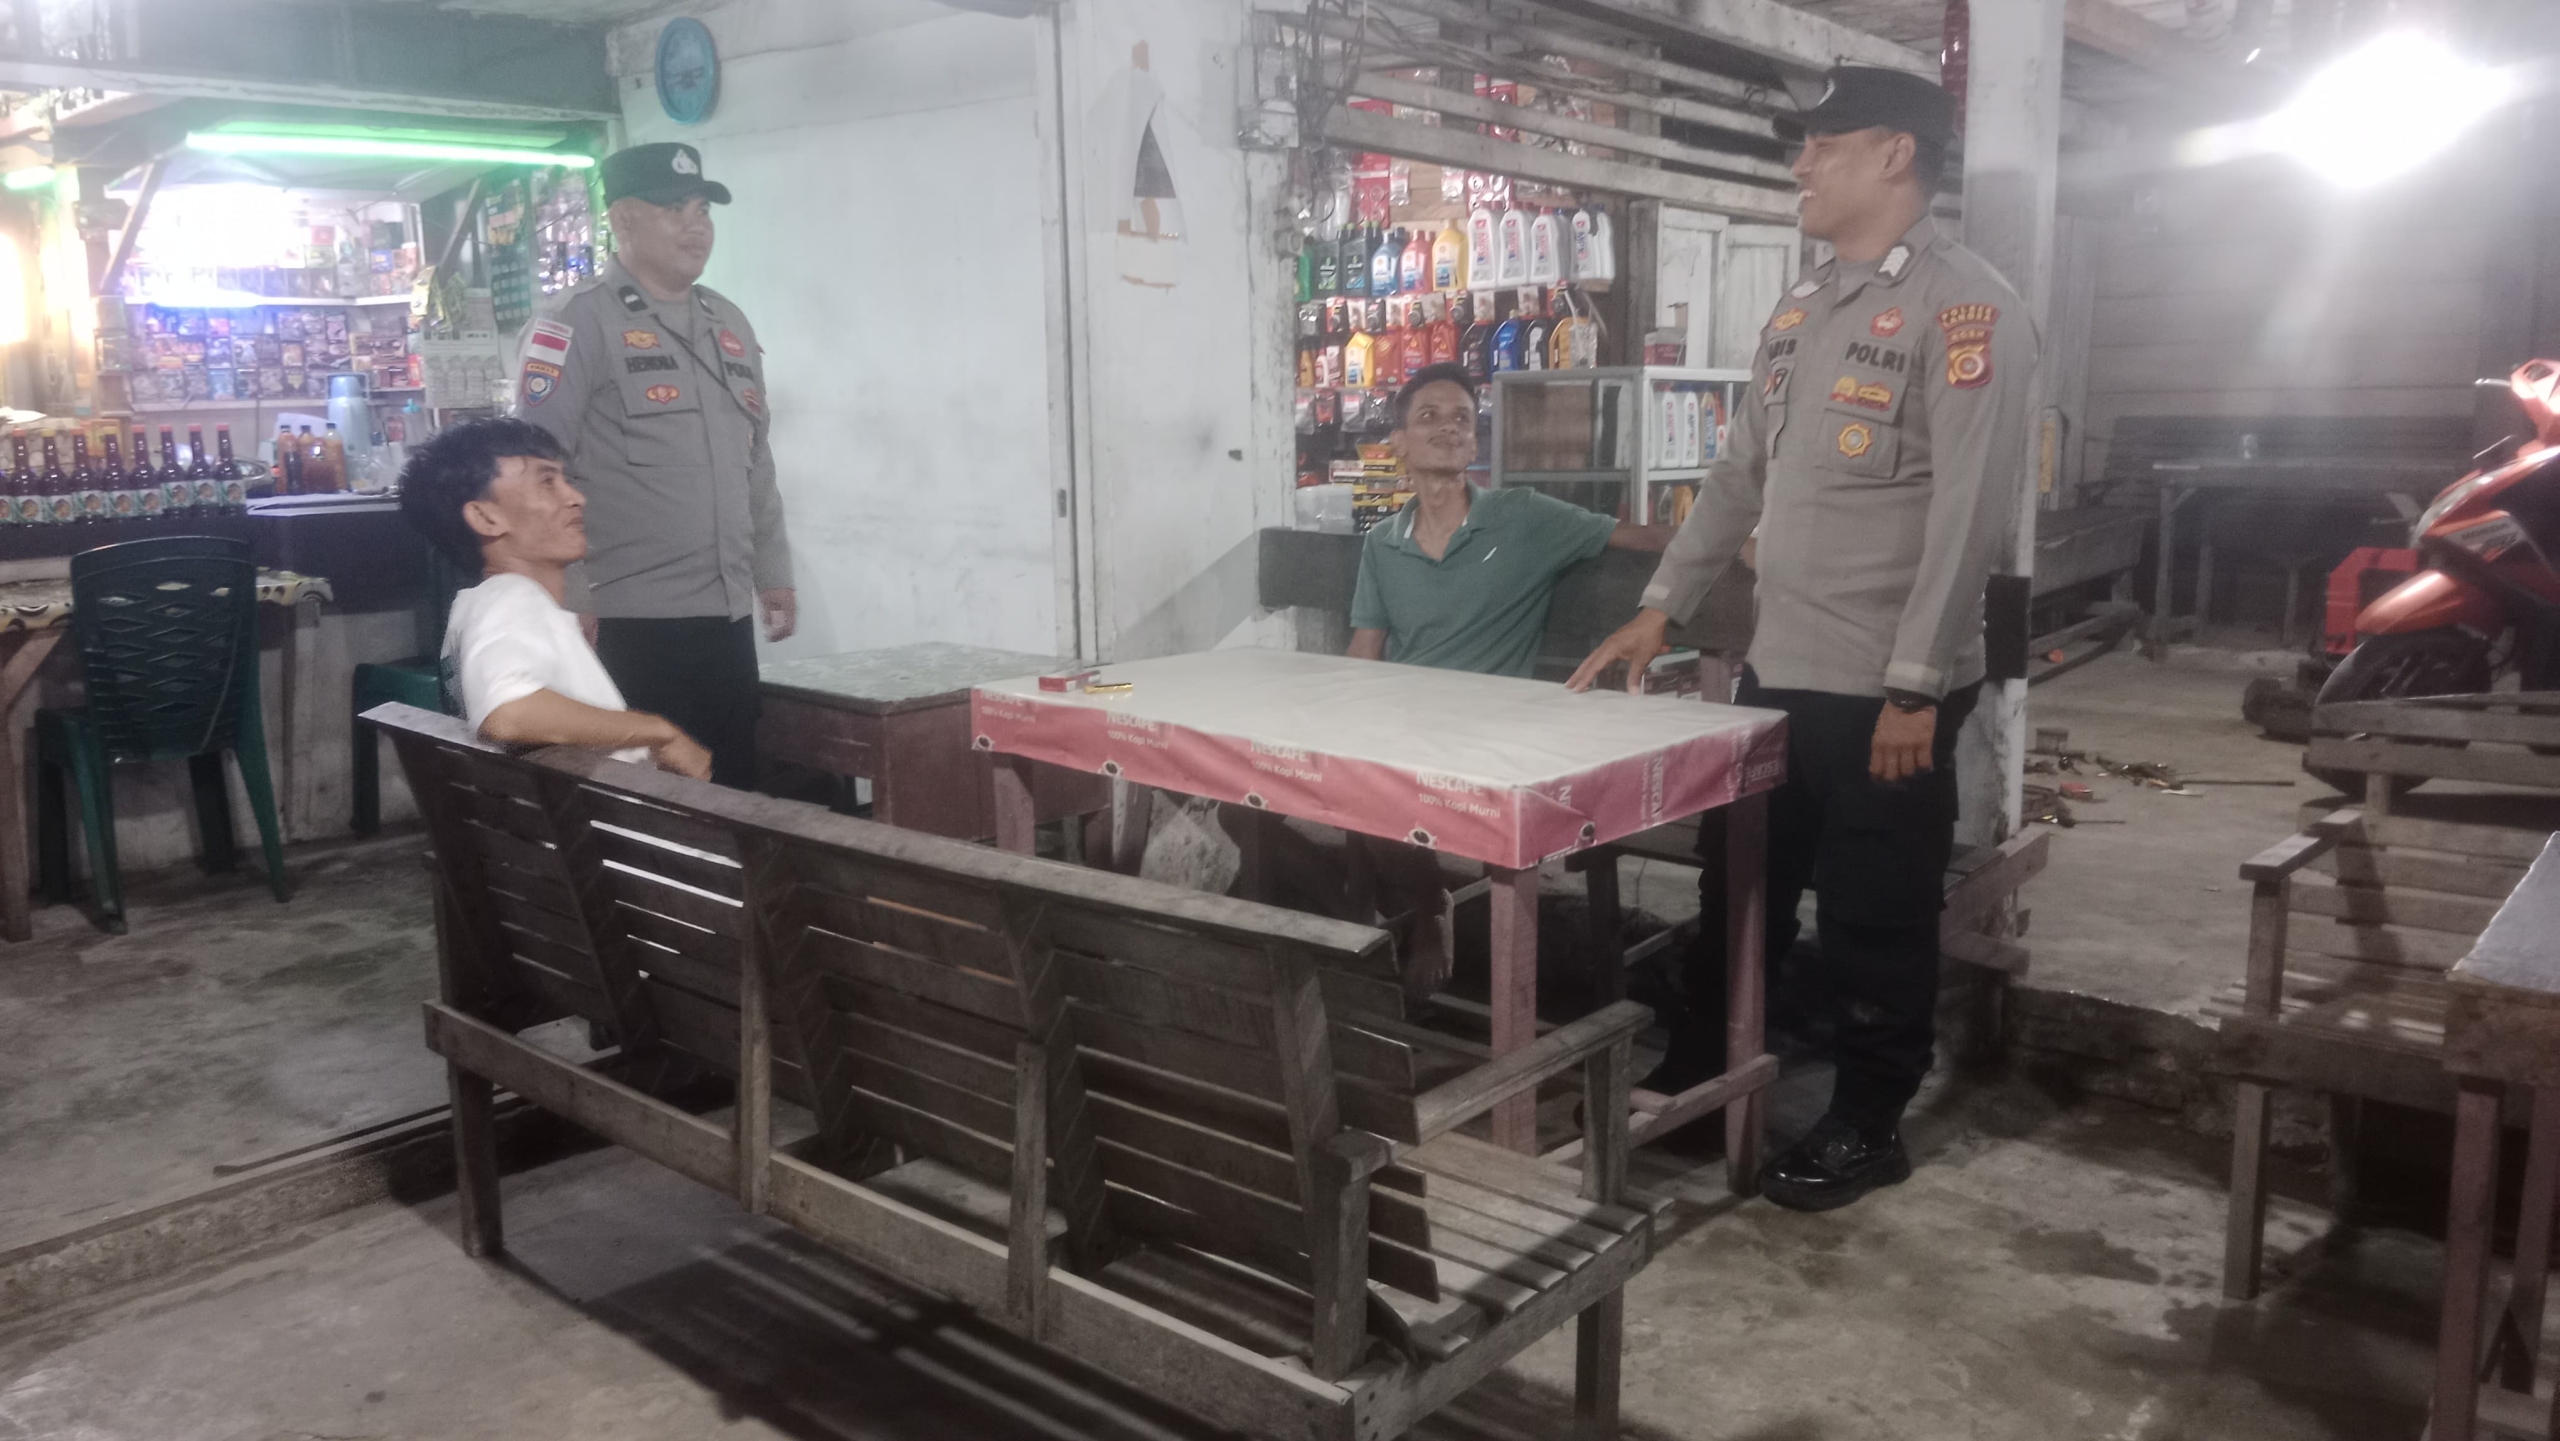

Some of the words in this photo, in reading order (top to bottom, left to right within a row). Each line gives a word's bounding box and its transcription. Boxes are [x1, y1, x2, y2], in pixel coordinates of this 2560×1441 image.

[1844, 342, 1906, 373] POLRI
[1273, 764, 1294, 778] Kopi
[1294, 769, 1322, 783] Murni
[1418, 793, 1443, 807] 100%
[1444, 798, 1468, 813] Kopi
[1468, 803, 1501, 819] Murni
